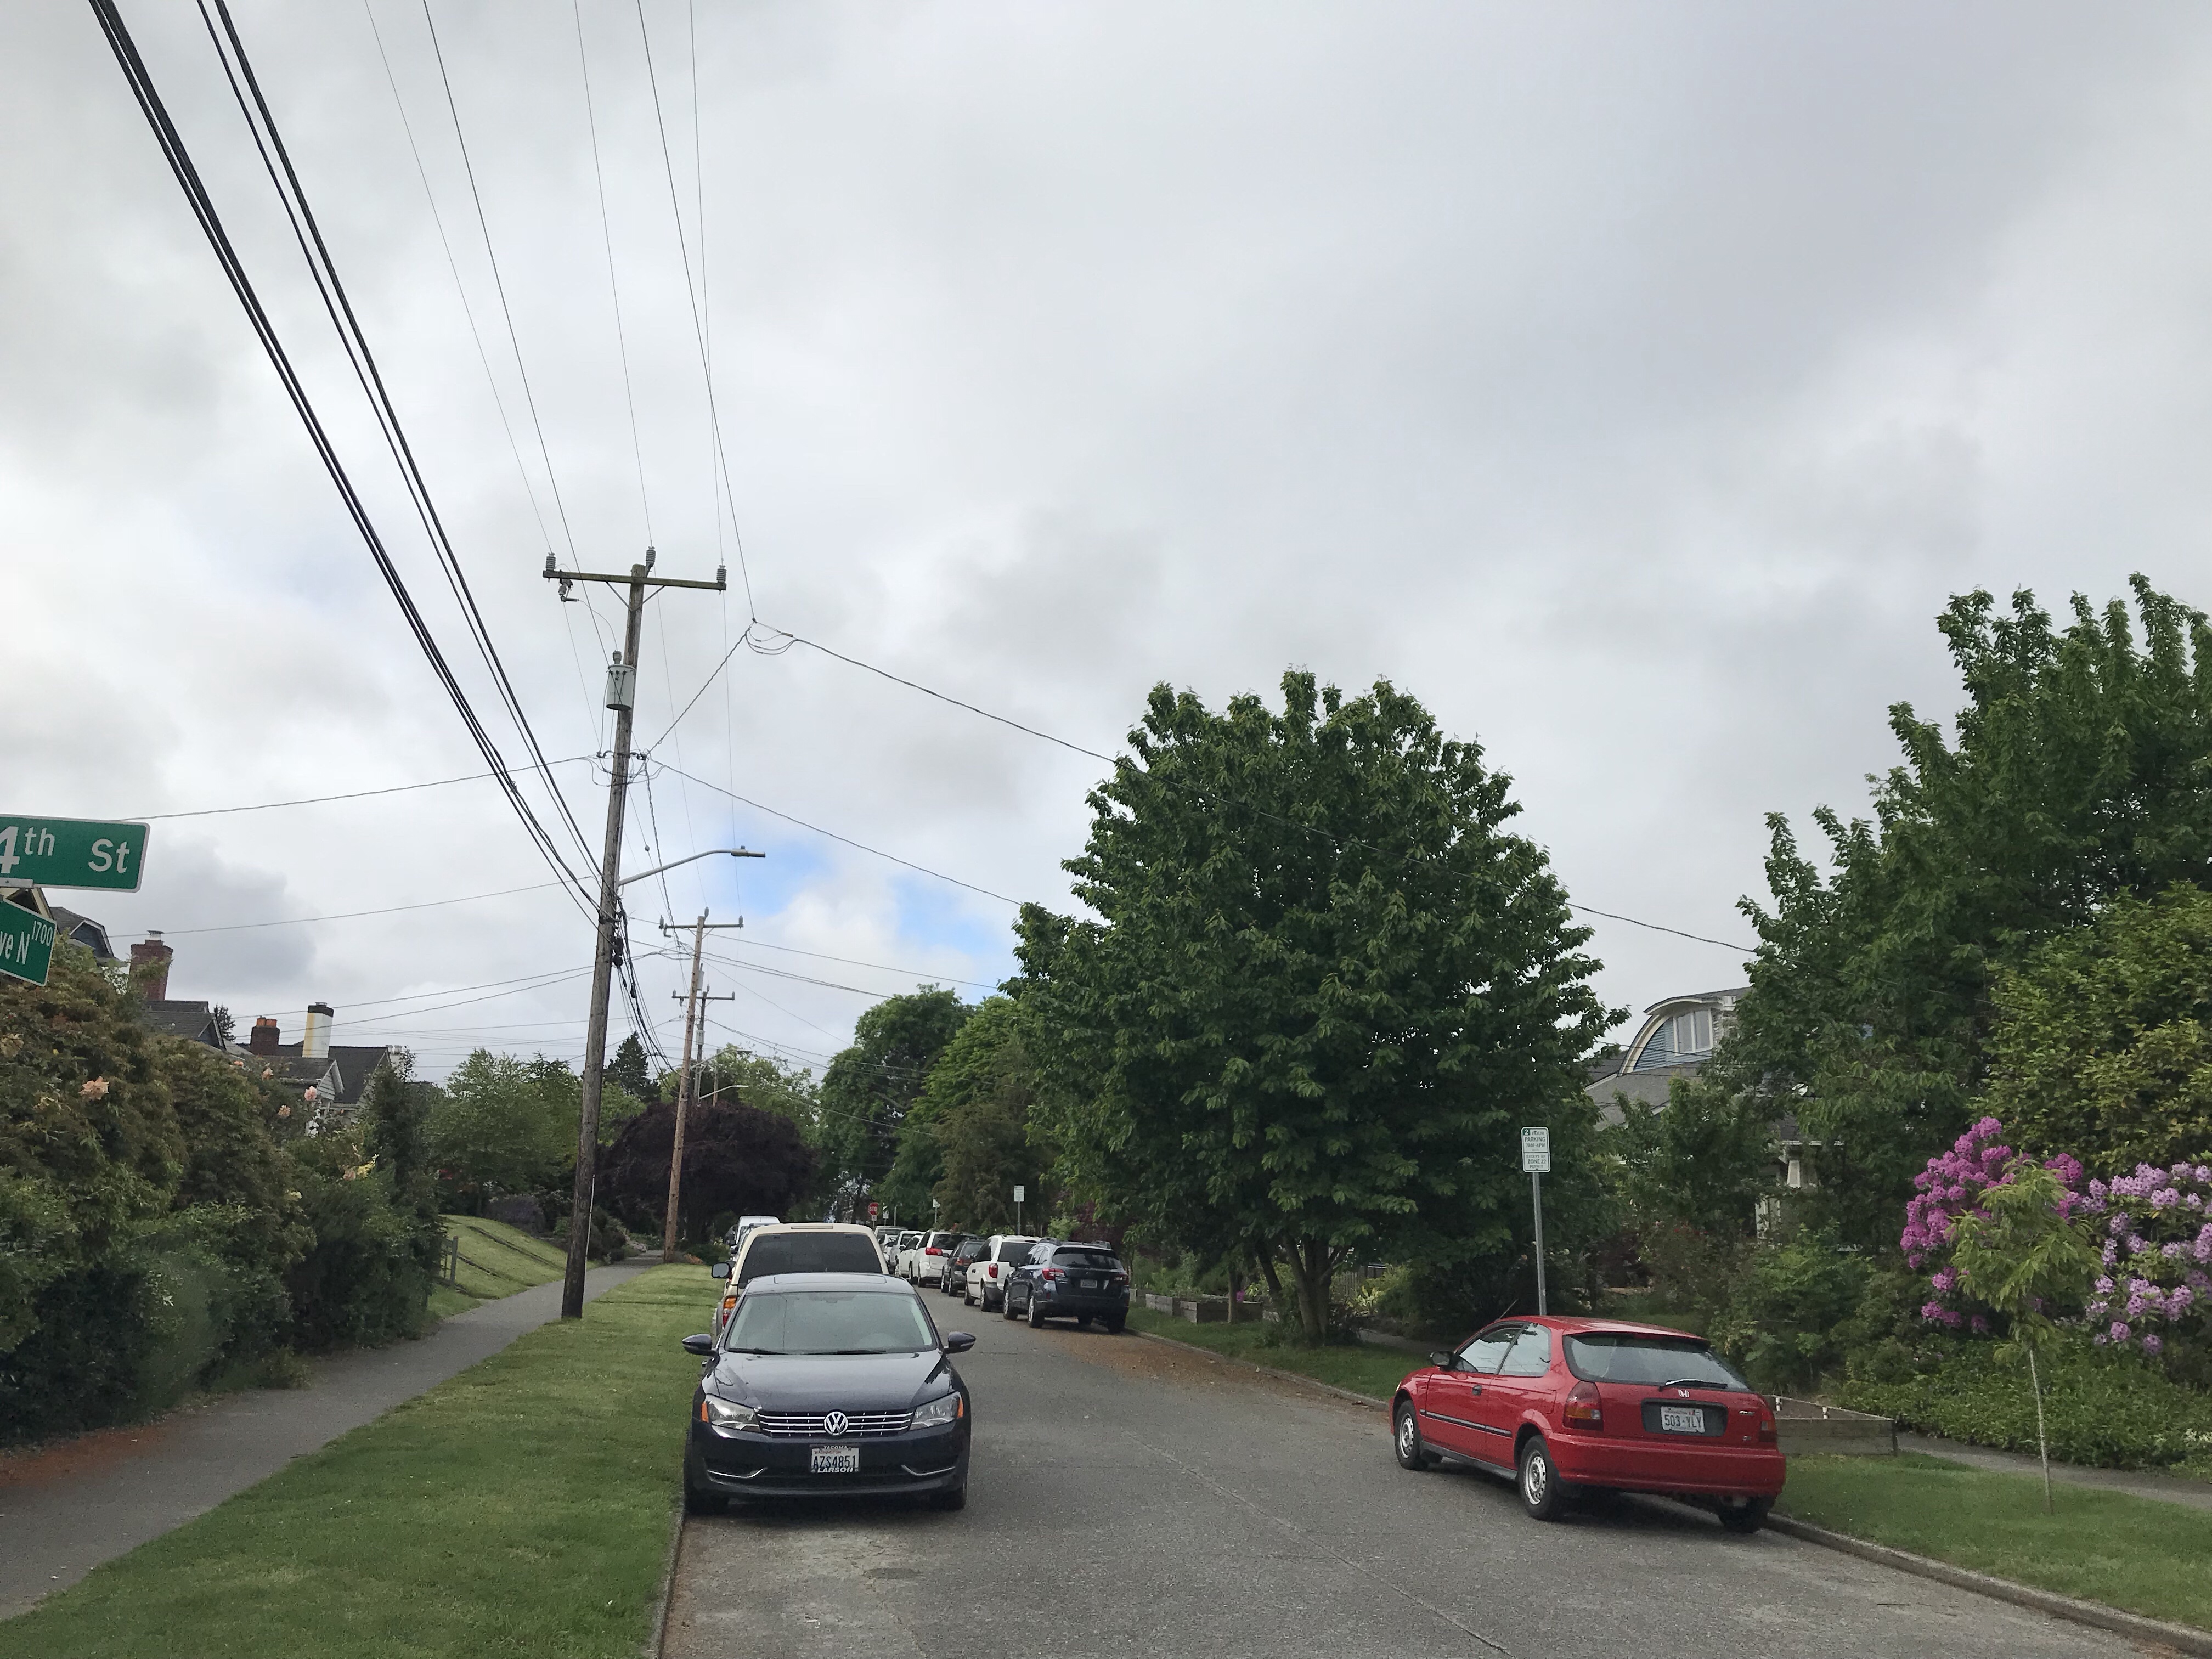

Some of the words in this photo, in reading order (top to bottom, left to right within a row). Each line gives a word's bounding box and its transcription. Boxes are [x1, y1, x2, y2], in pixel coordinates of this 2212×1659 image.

[88, 838, 130, 873] St
[16, 931, 30, 964] N
[32, 920, 53, 947] 1700
